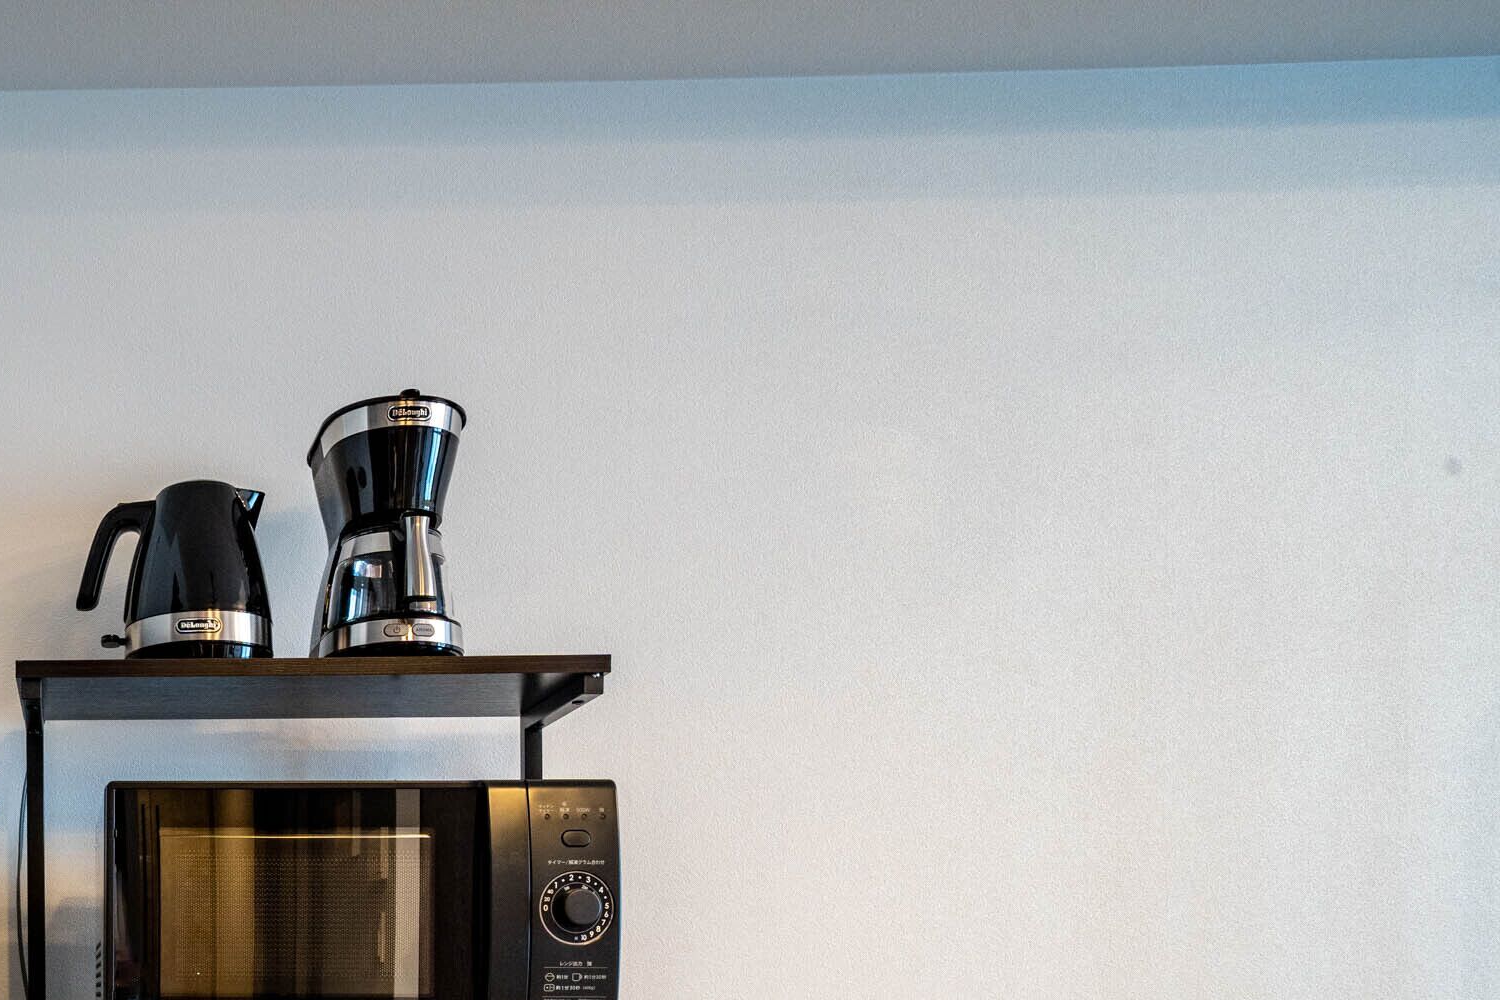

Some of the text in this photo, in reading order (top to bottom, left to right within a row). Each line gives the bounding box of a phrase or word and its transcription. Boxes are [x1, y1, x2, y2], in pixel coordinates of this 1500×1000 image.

[585, 876, 592, 884] 3
[554, 881, 558, 889] 1
[543, 904, 549, 912] 0
[604, 902, 610, 910] 5
[595, 925, 601, 933] 8
[589, 930, 595, 938] 9
